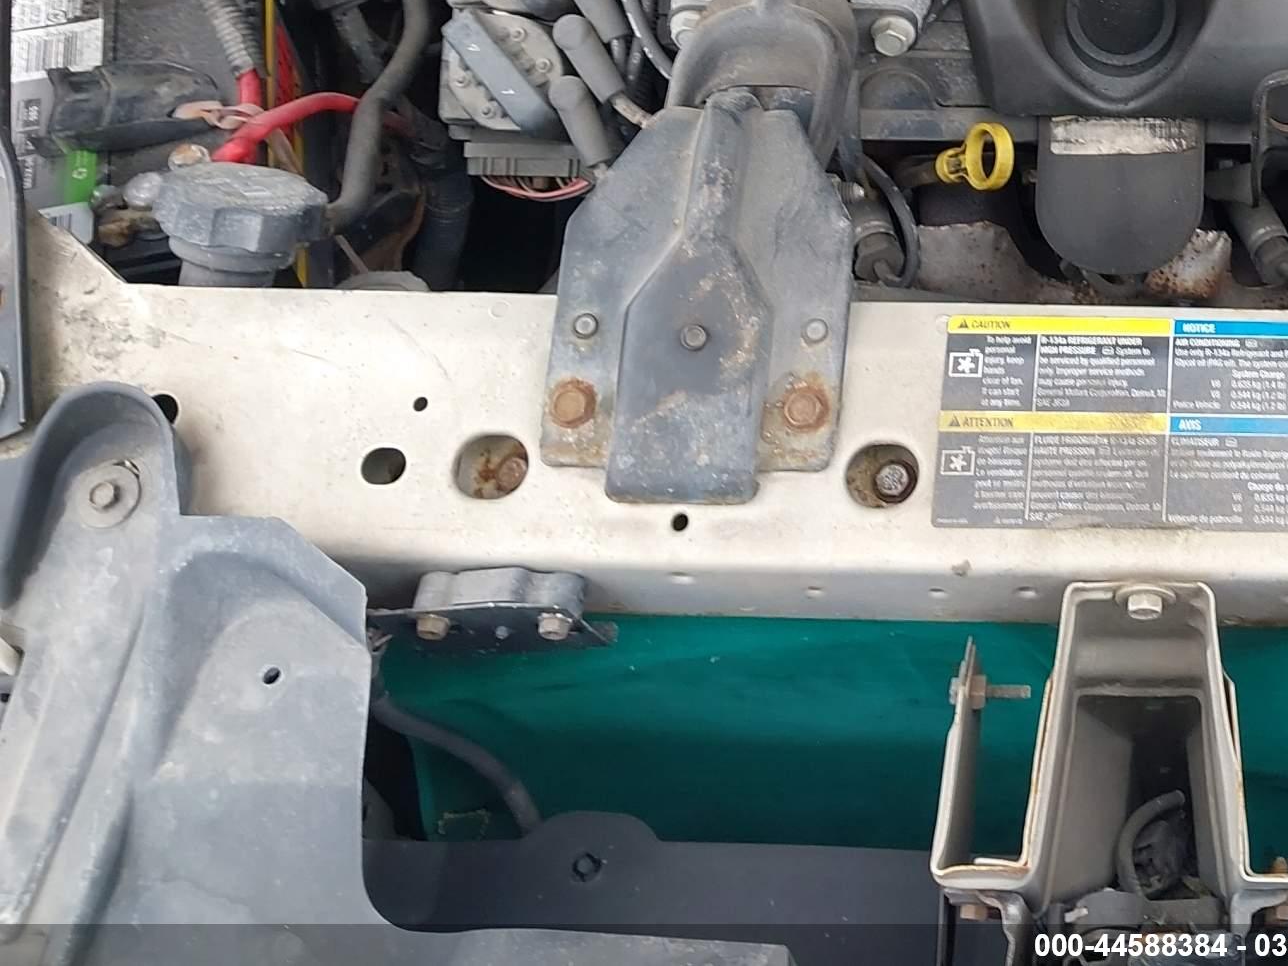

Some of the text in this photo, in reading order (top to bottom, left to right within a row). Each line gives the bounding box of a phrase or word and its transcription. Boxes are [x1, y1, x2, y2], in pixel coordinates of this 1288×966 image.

[971, 320, 1011, 329] CAUTION
[1182, 322, 1216, 333] NOTICE
[996, 336, 1011, 345] help
[1012, 336, 1032, 345] avoid
[1067, 336, 1116, 345] REFRIGERANT
[1116, 336, 1143, 346] UNDER
[1175, 338, 1188, 346] AIR
[1189, 338, 1240, 347] CONDITIONING
[985, 345, 1016, 355] personal
[1040, 346, 1151, 356] HIGH PRESSURE System to
[1175, 348, 1188, 356] Use
[1190, 349, 1204, 358] only
[1231, 349, 1269, 359] Refrigerant
[1270, 350, 1283, 358] and
[1006, 355, 1025, 366] keep
[1039, 356, 1156, 366] be serviced by qualified personnel
[1238, 359, 1251, 367] The
[1252, 360, 1277, 369] system
[1055, 366, 1087, 377] Improper
[1088, 367, 1113, 376] service
[1114, 368, 1145, 377] methods
[1232, 369, 1286, 380] System Charge
[1001, 376, 1010, 385] of
[1039, 378, 1053, 387] may
[1053, 378, 1075, 386] cause
[1251, 380, 1261, 390] kg
[1002, 386, 1020, 396] start
[1038, 387, 1064, 396] General
[1064, 387, 1088, 397] Motors
[1251, 391, 1261, 401] kg
[989, 398, 1002, 408] any
[1251, 401, 1261, 411] kg
[963, 417, 1013, 427] ATTENTION
[1178, 419, 1202, 431] AVIS
[1058, 446, 1095, 456] PRESSION
[1247, 482, 1274, 493] Charge
[1274, 483, 1285, 492] du
[1057, 501, 1083, 511] Motors
